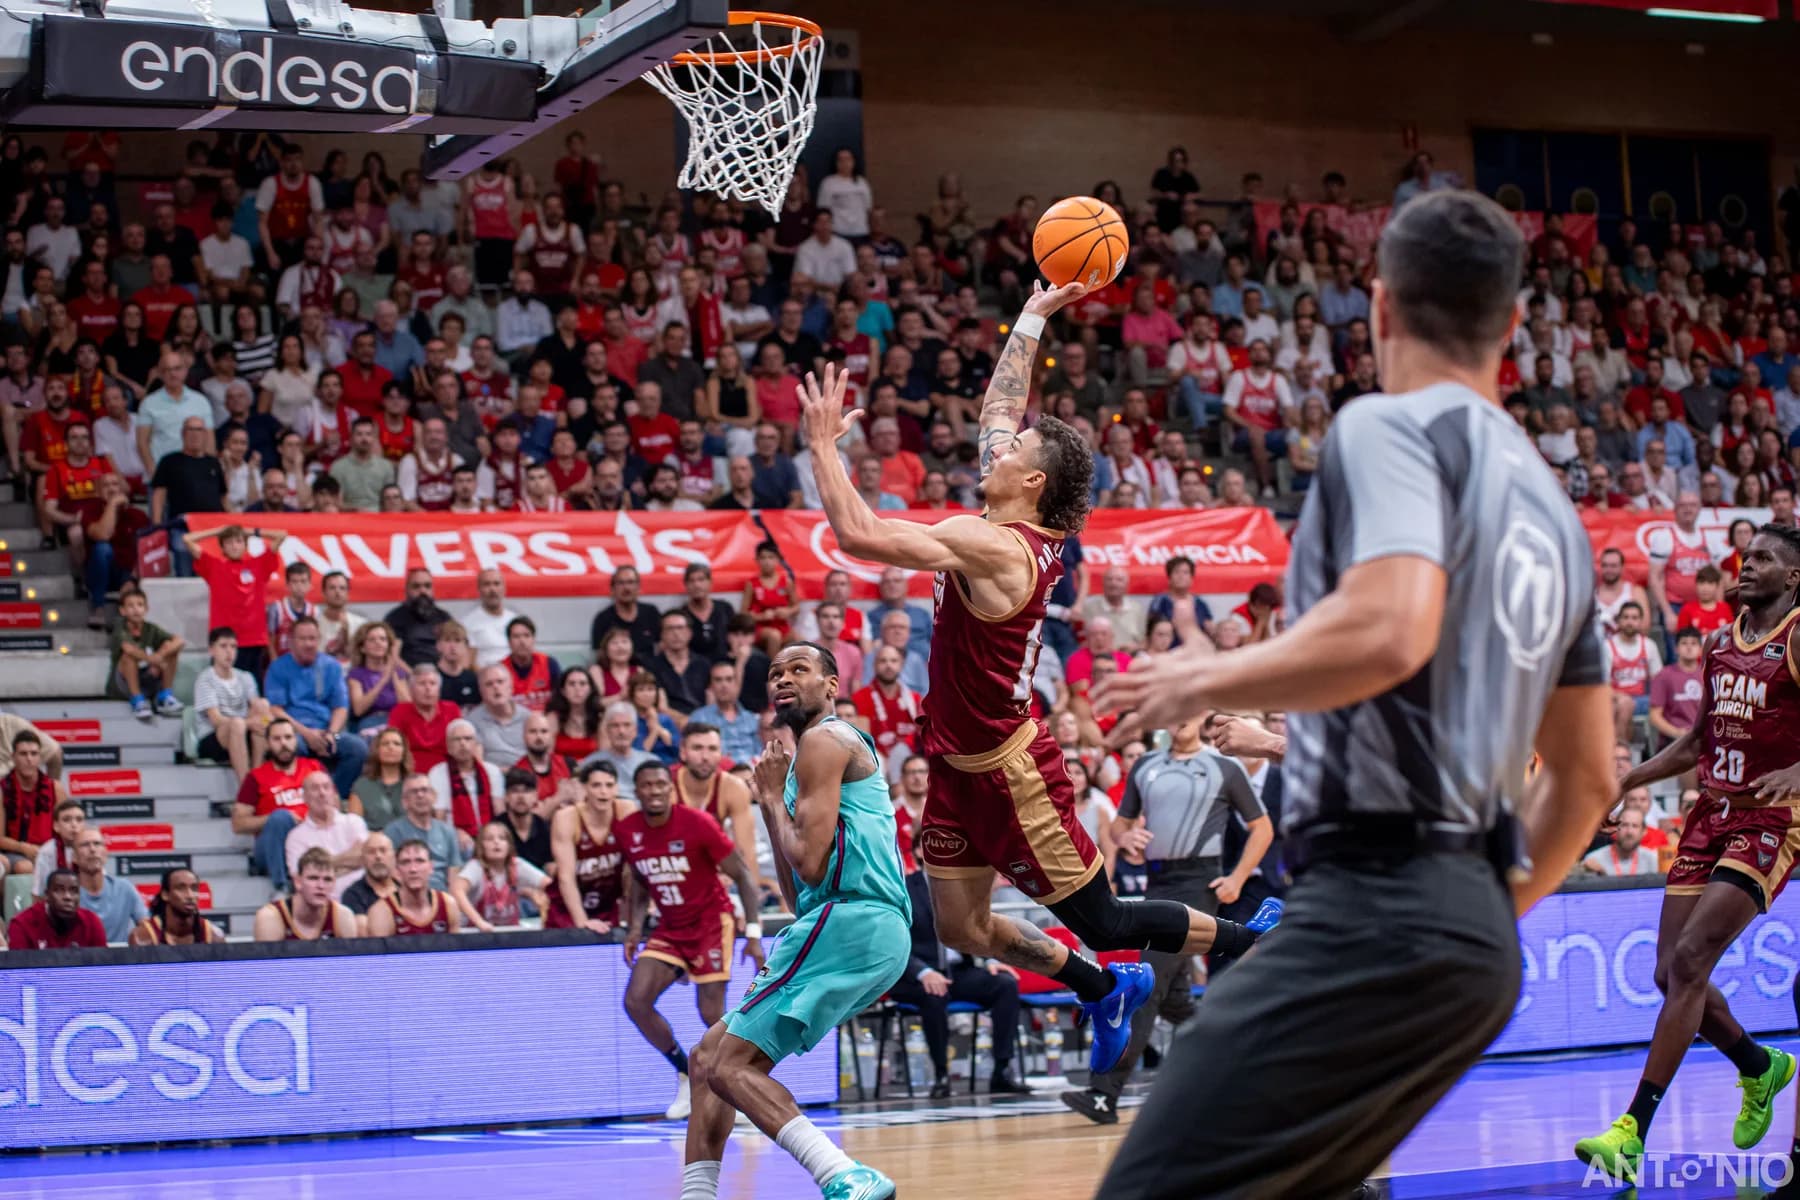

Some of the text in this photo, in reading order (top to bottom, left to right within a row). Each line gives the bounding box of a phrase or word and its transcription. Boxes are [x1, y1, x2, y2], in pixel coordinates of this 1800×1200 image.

[121, 37, 419, 114] endesa
[1083, 544, 1129, 565] DE
[1712, 746, 1746, 783] 20
[925, 834, 962, 850] Juver
[635, 855, 691, 875] UCAM
[656, 884, 685, 906] 31
